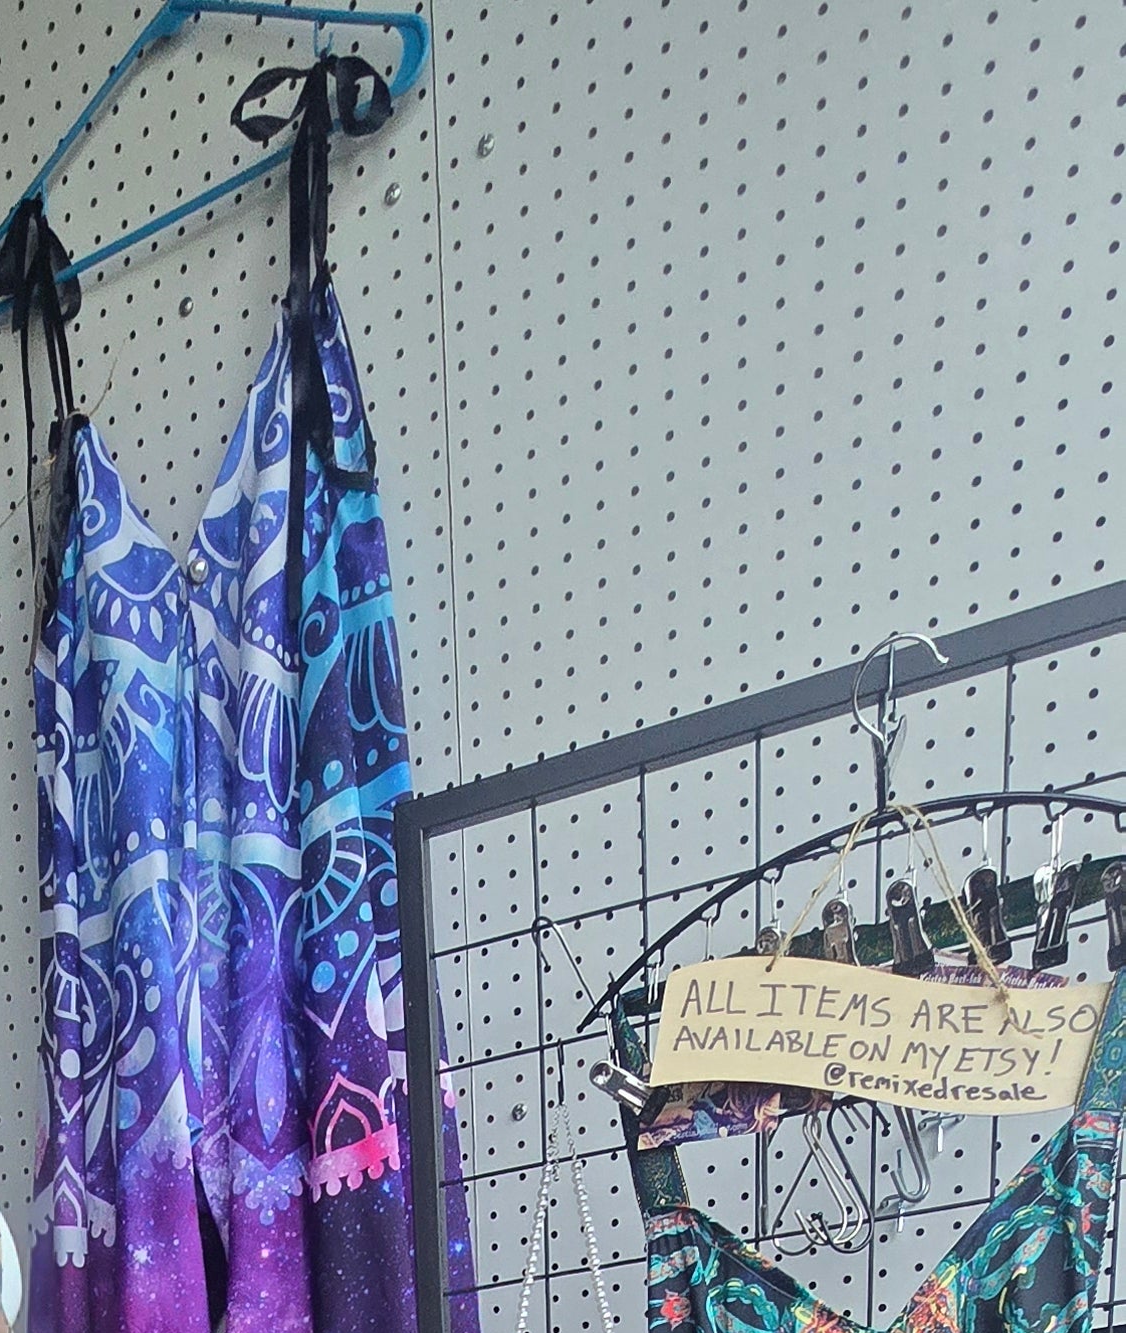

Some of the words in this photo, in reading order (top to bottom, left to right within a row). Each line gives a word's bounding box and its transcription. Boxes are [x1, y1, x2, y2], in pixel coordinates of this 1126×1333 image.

[680, 978, 746, 1019] ALL
[756, 983, 892, 1029] ITEMS
[910, 998, 989, 1034] ARE
[998, 1003, 1100, 1037] ALSO
[673, 1025, 846, 1057] AVAILABLE
[848, 1033, 892, 1063] ON
[900, 1043, 950, 1079] MY
[959, 1038, 1062, 1077] ETSY!
[823, 1061, 1048, 1102] @remixedresale
